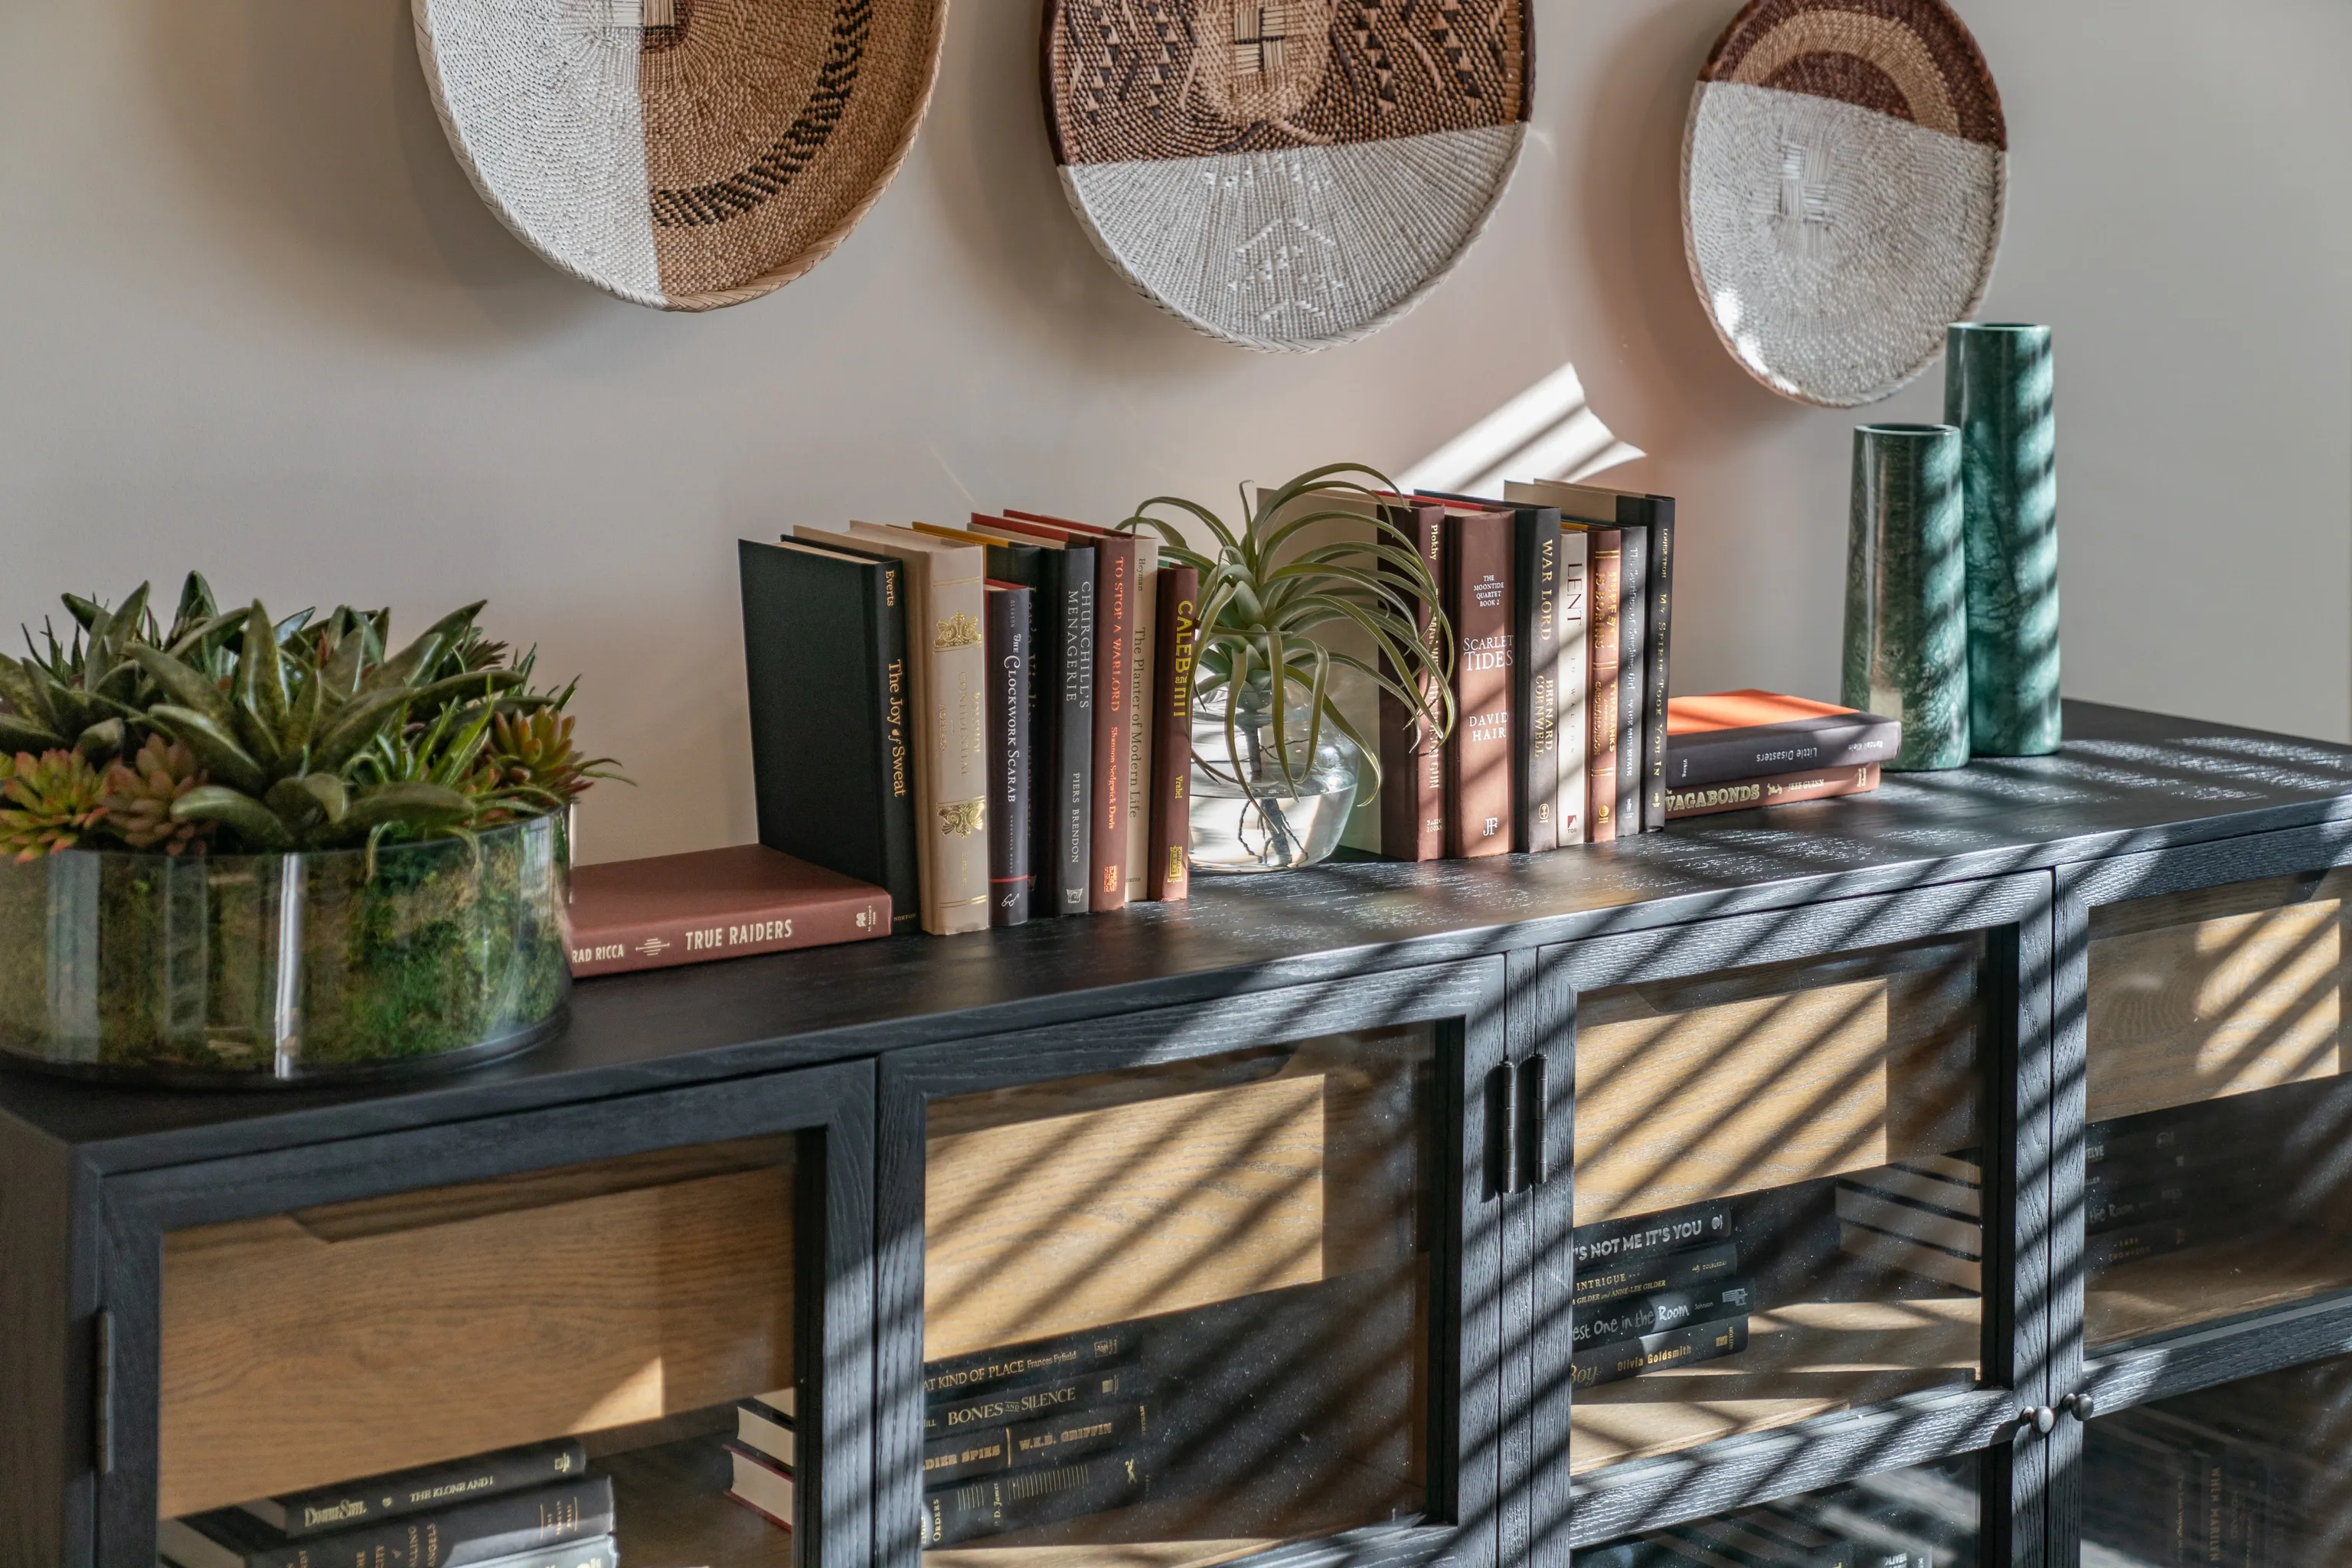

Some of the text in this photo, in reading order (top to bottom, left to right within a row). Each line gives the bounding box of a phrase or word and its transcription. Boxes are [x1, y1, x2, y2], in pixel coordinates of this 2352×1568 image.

[1429, 524, 1439, 560] Plokhy
[885, 570, 894, 607] Everts
[1136, 557, 1146, 592] Heyman
[1473, 581, 1504, 591] MOONTIDE
[1483, 574, 1495, 583] THE
[1540, 538, 1553, 641] WAR LORD
[1476, 590, 1502, 599] QUARTET
[1566, 563, 1583, 626] LENT
[1595, 572, 1606, 649] IS BORING
[1607, 570, 1618, 651] PERFECT
[1066, 590, 1079, 701] MENAGERIE
[1080, 581, 1091, 708] CHURCHILL'S
[1111, 556, 1124, 712] TO STOP A WARLORD
[1174, 599, 1194, 674] CALEB
[1463, 635, 1514, 652] SCARLET
[887, 658, 903, 693] The
[1463, 650, 1514, 671] TIDES
[887, 696, 903, 726] Joy
[1544, 679, 1553, 751] BERNARD
[1655, 679, 1664, 716] TOOK
[958, 671, 969, 779] CONFIDENTIAL
[1004, 633, 1021, 802] THE CLOCKWORK SCARAB
[1129, 626, 1145, 818] The Planter of Modern Life
[1468, 711, 1508, 727] DAVID
[1472, 727, 1508, 742] HAIR
[1534, 675, 1545, 758] CORNWELL
[1655, 723, 1664, 753] YOU
[1756, 746, 1818, 763] Little Disasters
[1847, 742, 1863, 752] Klein
[892, 746, 906, 798] Sweat
[1108, 764, 1118, 805] Sedgwick
[1653, 761, 1663, 776] IN
[1174, 775, 1183, 799] Vrabel
[1664, 783, 1760, 812] VAGABONDS
[1787, 779, 1803, 792] JEFF
[1071, 772, 1080, 864] PIERS BRENDON
[1108, 805, 1116, 831] Davis
[893, 913, 917, 923] NORTON
[595, 943, 625, 962] RICCA
[685, 928, 723, 951] TRUE
[729, 919, 793, 945] RAIDERS
[1573, 1220, 1702, 1261] 'S NOT ME IT'S YOU
[1576, 1272, 1626, 1292] INTRIGUE
[1576, 1294, 1600, 1305] GILDER
[1643, 1279, 1666, 1292] GILDER
[1593, 1318, 1619, 1336] One
[1622, 1315, 1633, 1329] in
[1634, 1308, 1656, 1328] the
[1657, 1303, 1690, 1321] Room
[1694, 1301, 1714, 1311] Johnson
[938, 1372, 968, 1390] KIND
[969, 1367, 986, 1383] OF
[988, 1360, 1024, 1379] PLACE
[1026, 1356, 1054, 1369] Frances
[1053, 1350, 1076, 1366] Fyfield
[1617, 1357, 1644, 1373] Olivia
[1647, 1344, 1692, 1365] Goldsmith
[947, 1401, 1004, 1426] BONES
[1004, 1403, 1021, 1411] AND
[1021, 1387, 1076, 1412] SILENCE
[961, 1444, 1001, 1464] SPIES
[1018, 1432, 1057, 1452] W.E.B.
[1060, 1422, 1113, 1444] GRIFFIN
[409, 1475, 495, 1503] THE KLONE AND I
[993, 1482, 1002, 1507] James
[932, 1498, 942, 1543] ORDERS
[2208, 1466, 2223, 1563] WHEN MARILYN
